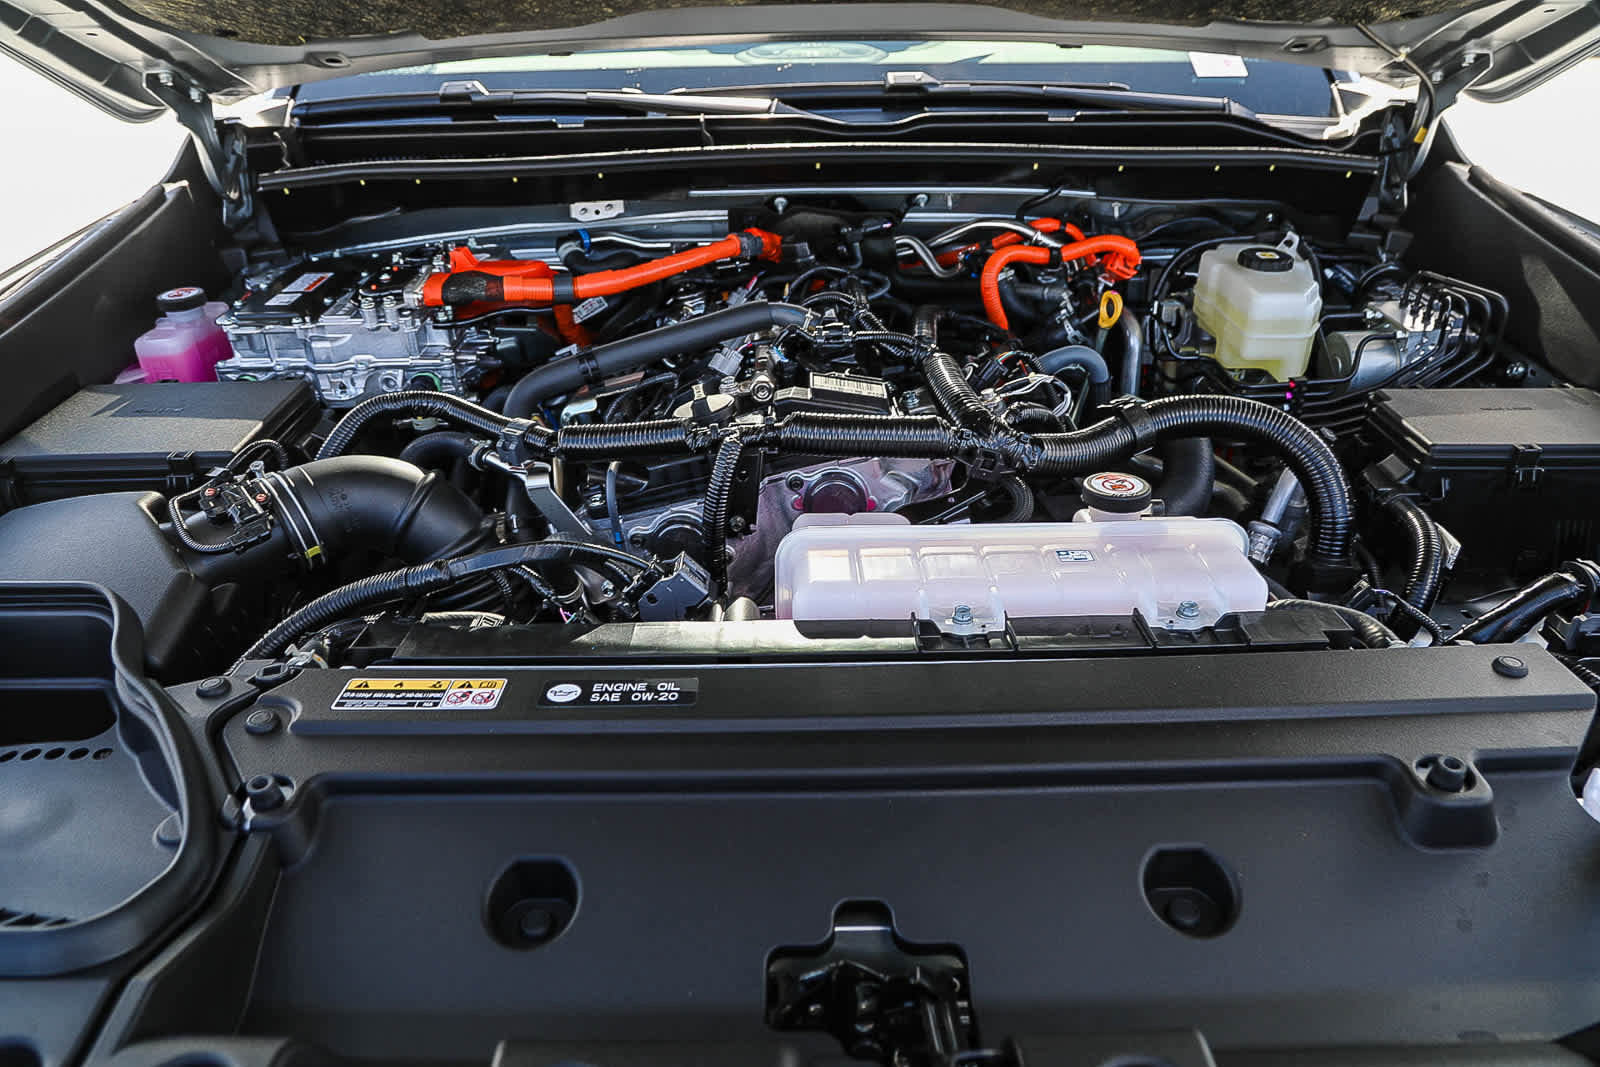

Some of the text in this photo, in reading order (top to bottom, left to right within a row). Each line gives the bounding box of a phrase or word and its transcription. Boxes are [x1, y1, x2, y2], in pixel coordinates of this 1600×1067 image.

[592, 682, 680, 692] ENGINE OIL
[590, 692, 679, 702] SAE 0W-20
